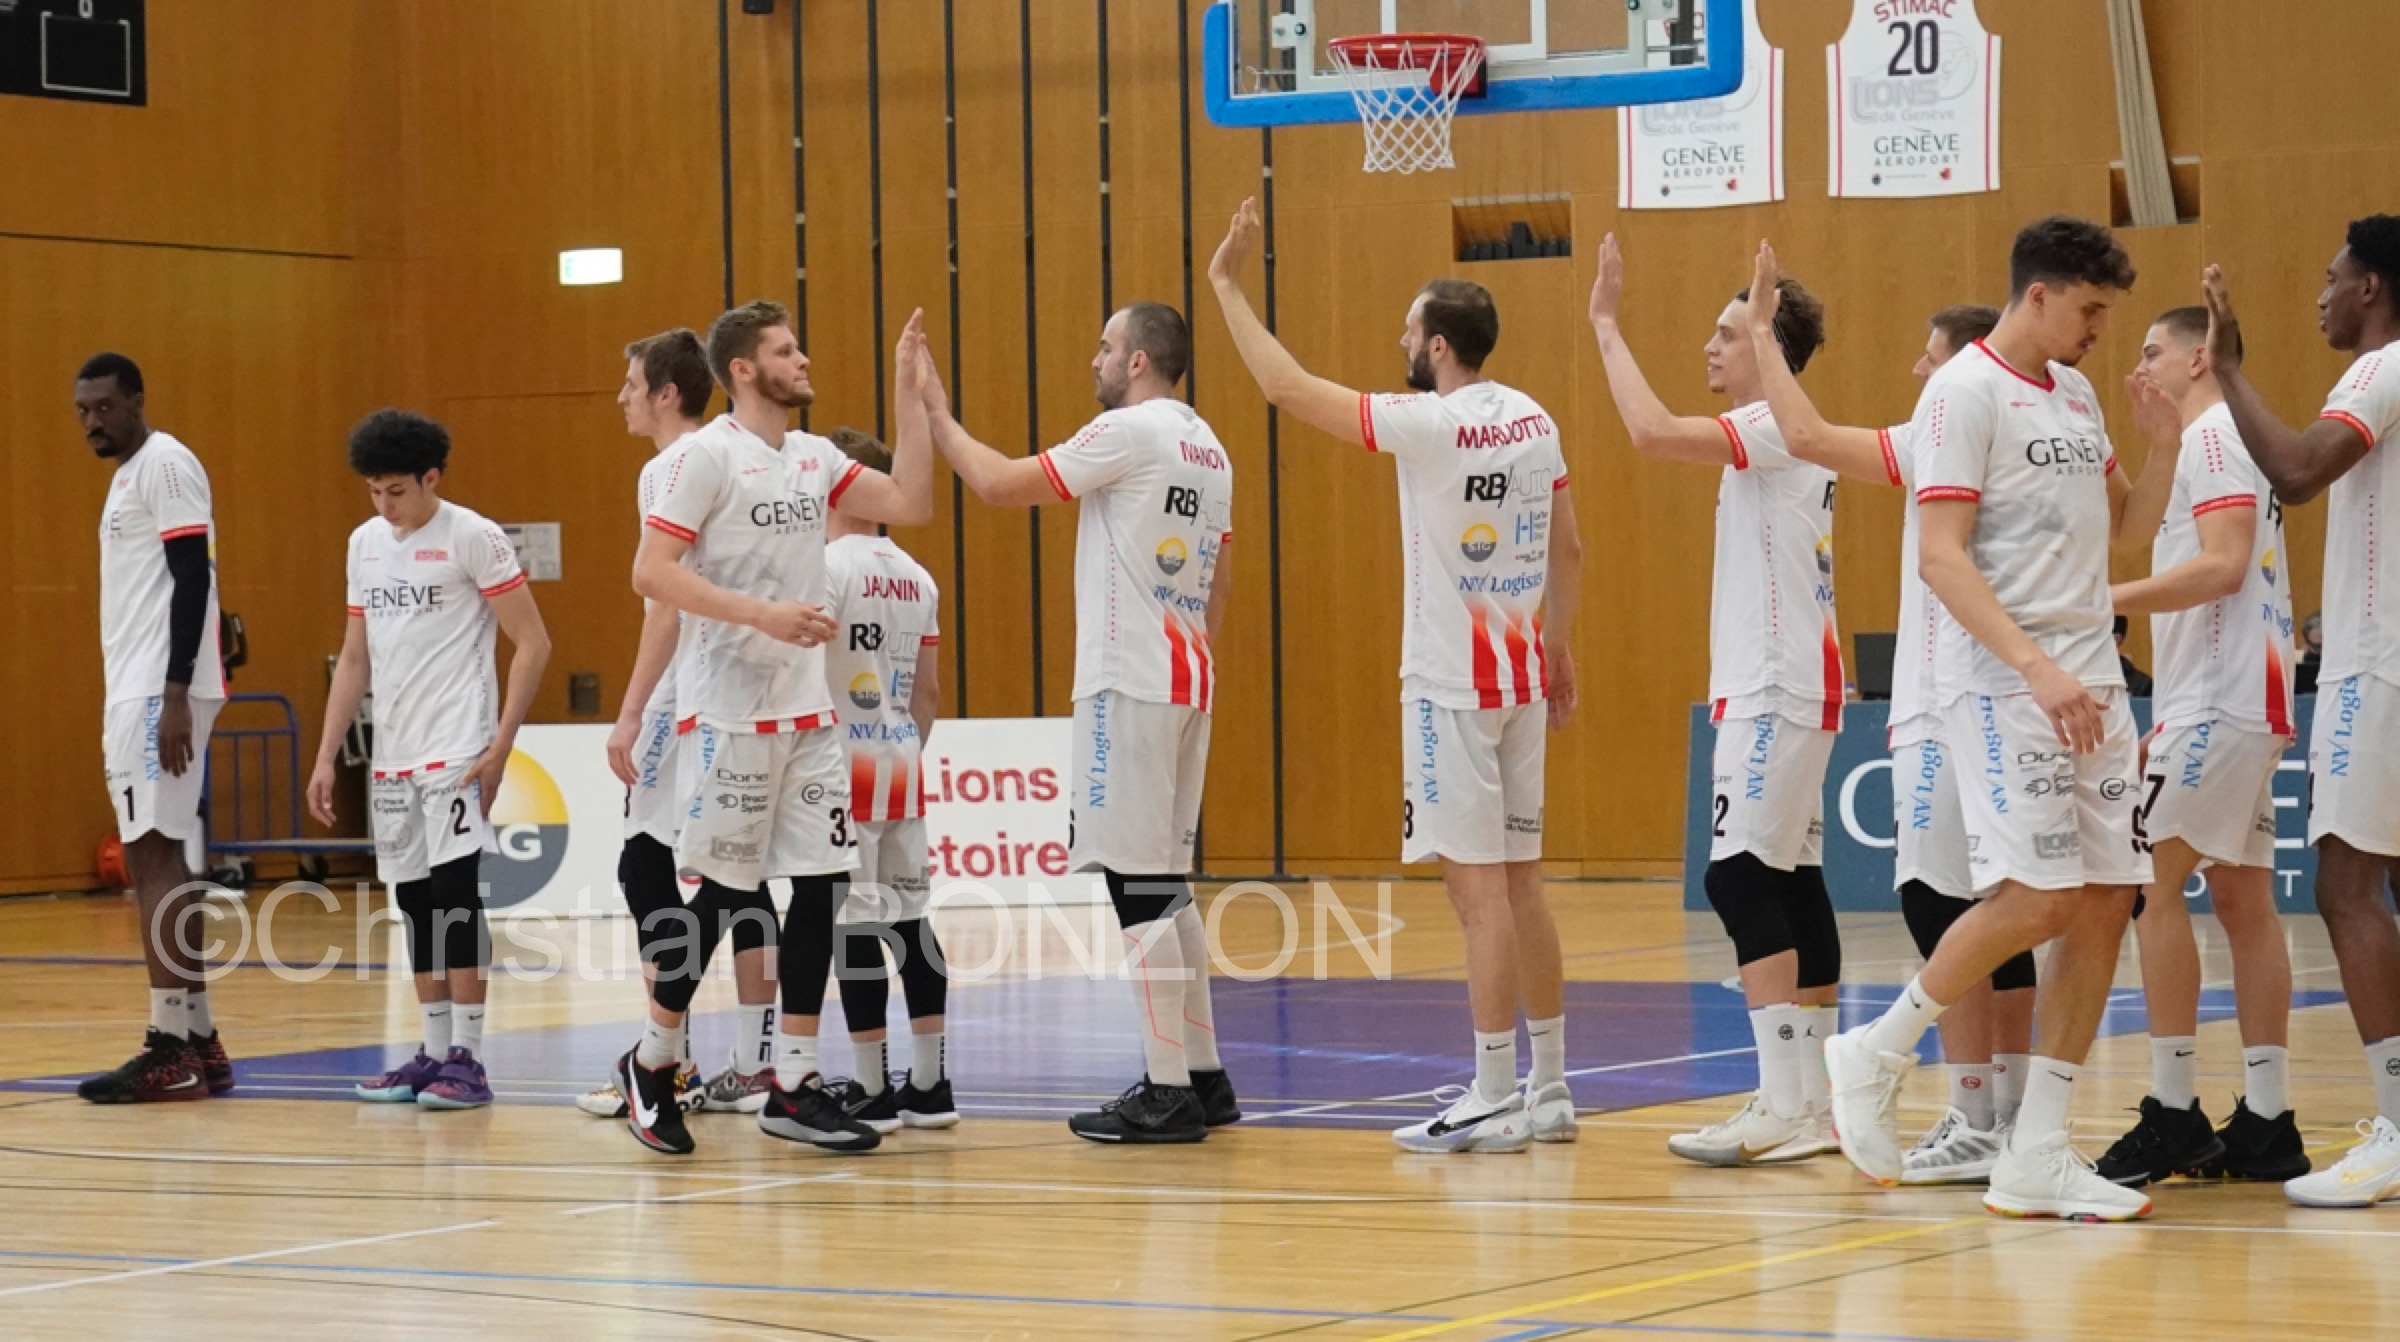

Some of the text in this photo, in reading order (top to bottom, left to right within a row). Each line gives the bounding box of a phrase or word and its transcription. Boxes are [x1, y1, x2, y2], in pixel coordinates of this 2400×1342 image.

[1888, 20, 1939, 76] 20
[862, 576, 920, 602] JAUNIN
[924, 757, 1059, 803] ions
[122, 785, 134, 822] 1
[450, 798, 470, 836] 2
